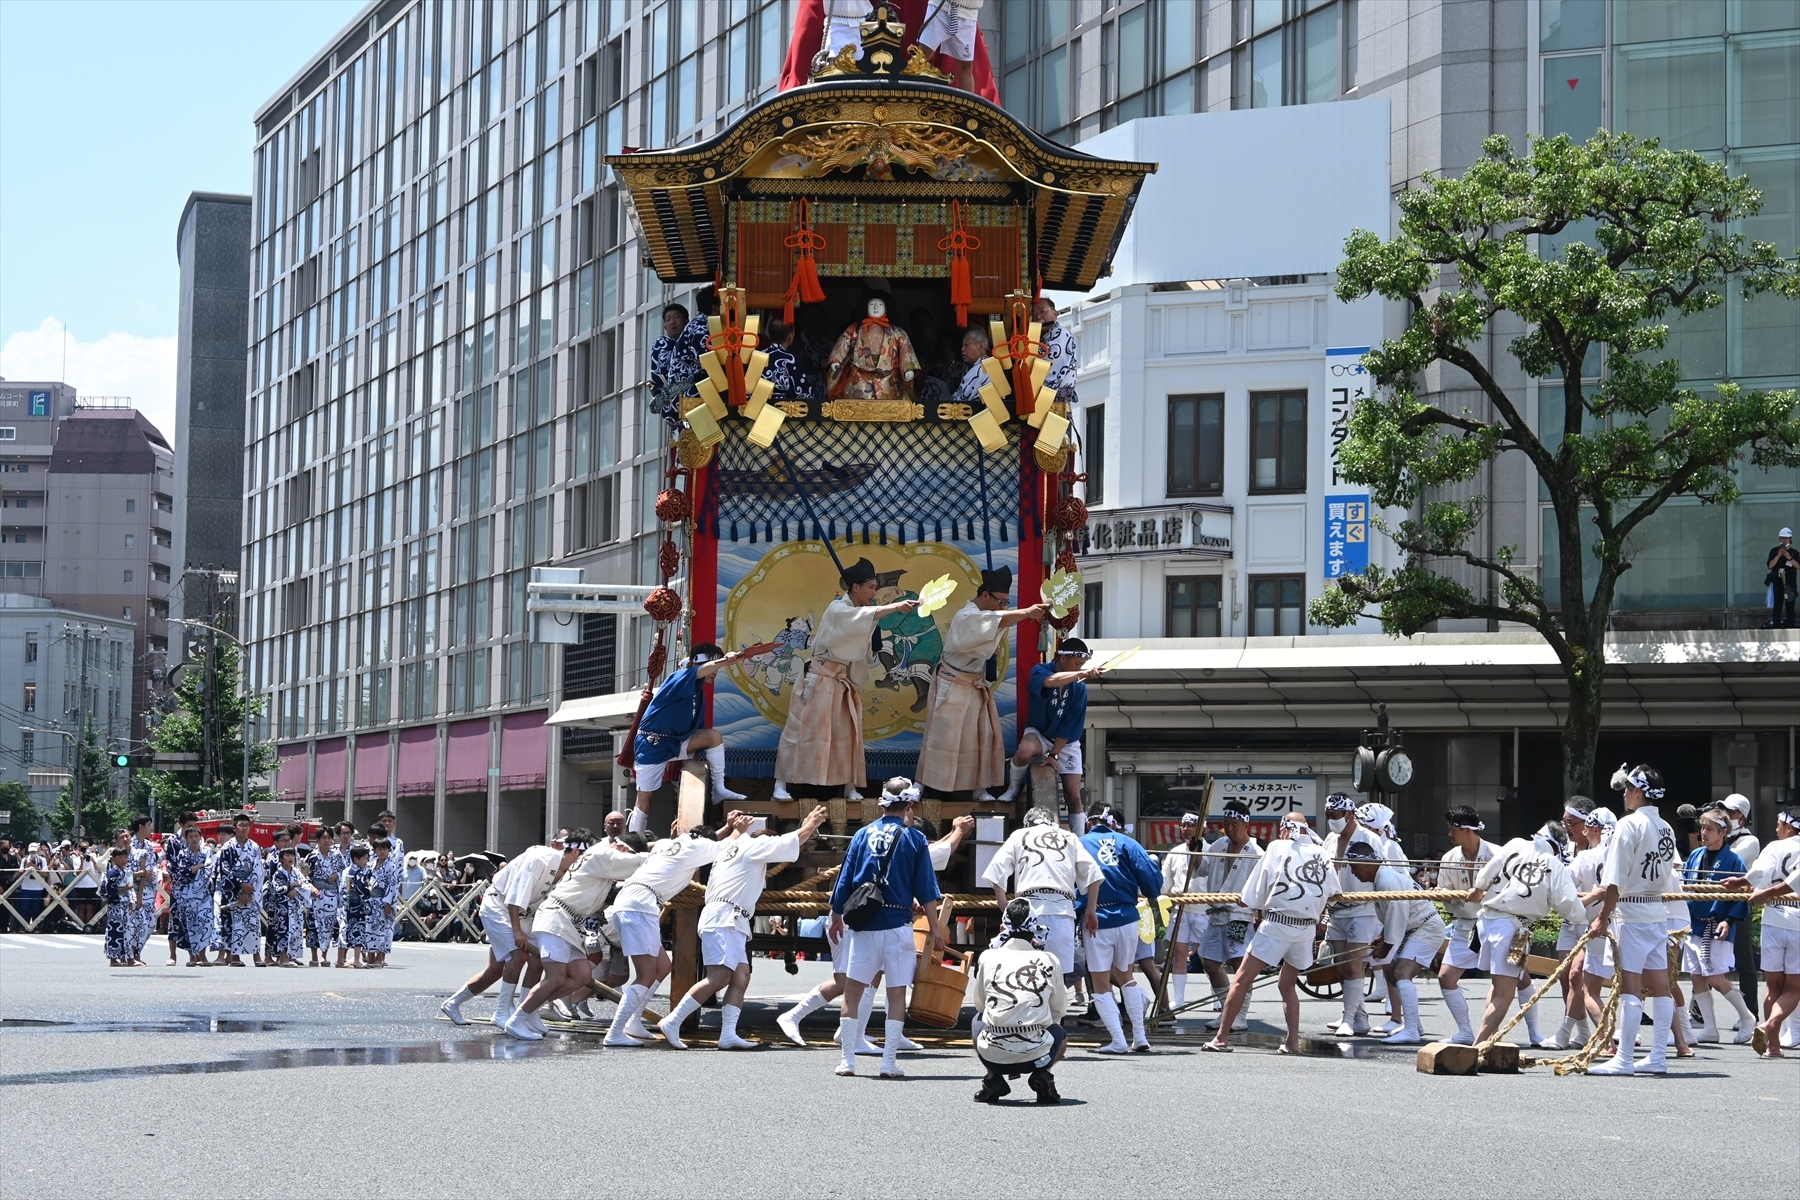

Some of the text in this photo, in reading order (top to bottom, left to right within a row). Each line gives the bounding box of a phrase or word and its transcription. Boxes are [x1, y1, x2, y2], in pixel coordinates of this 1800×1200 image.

[1328, 502, 1346, 576] 買えます
[1348, 504, 1363, 541] すぐ
[1248, 783, 1303, 792] メガネスーパー
